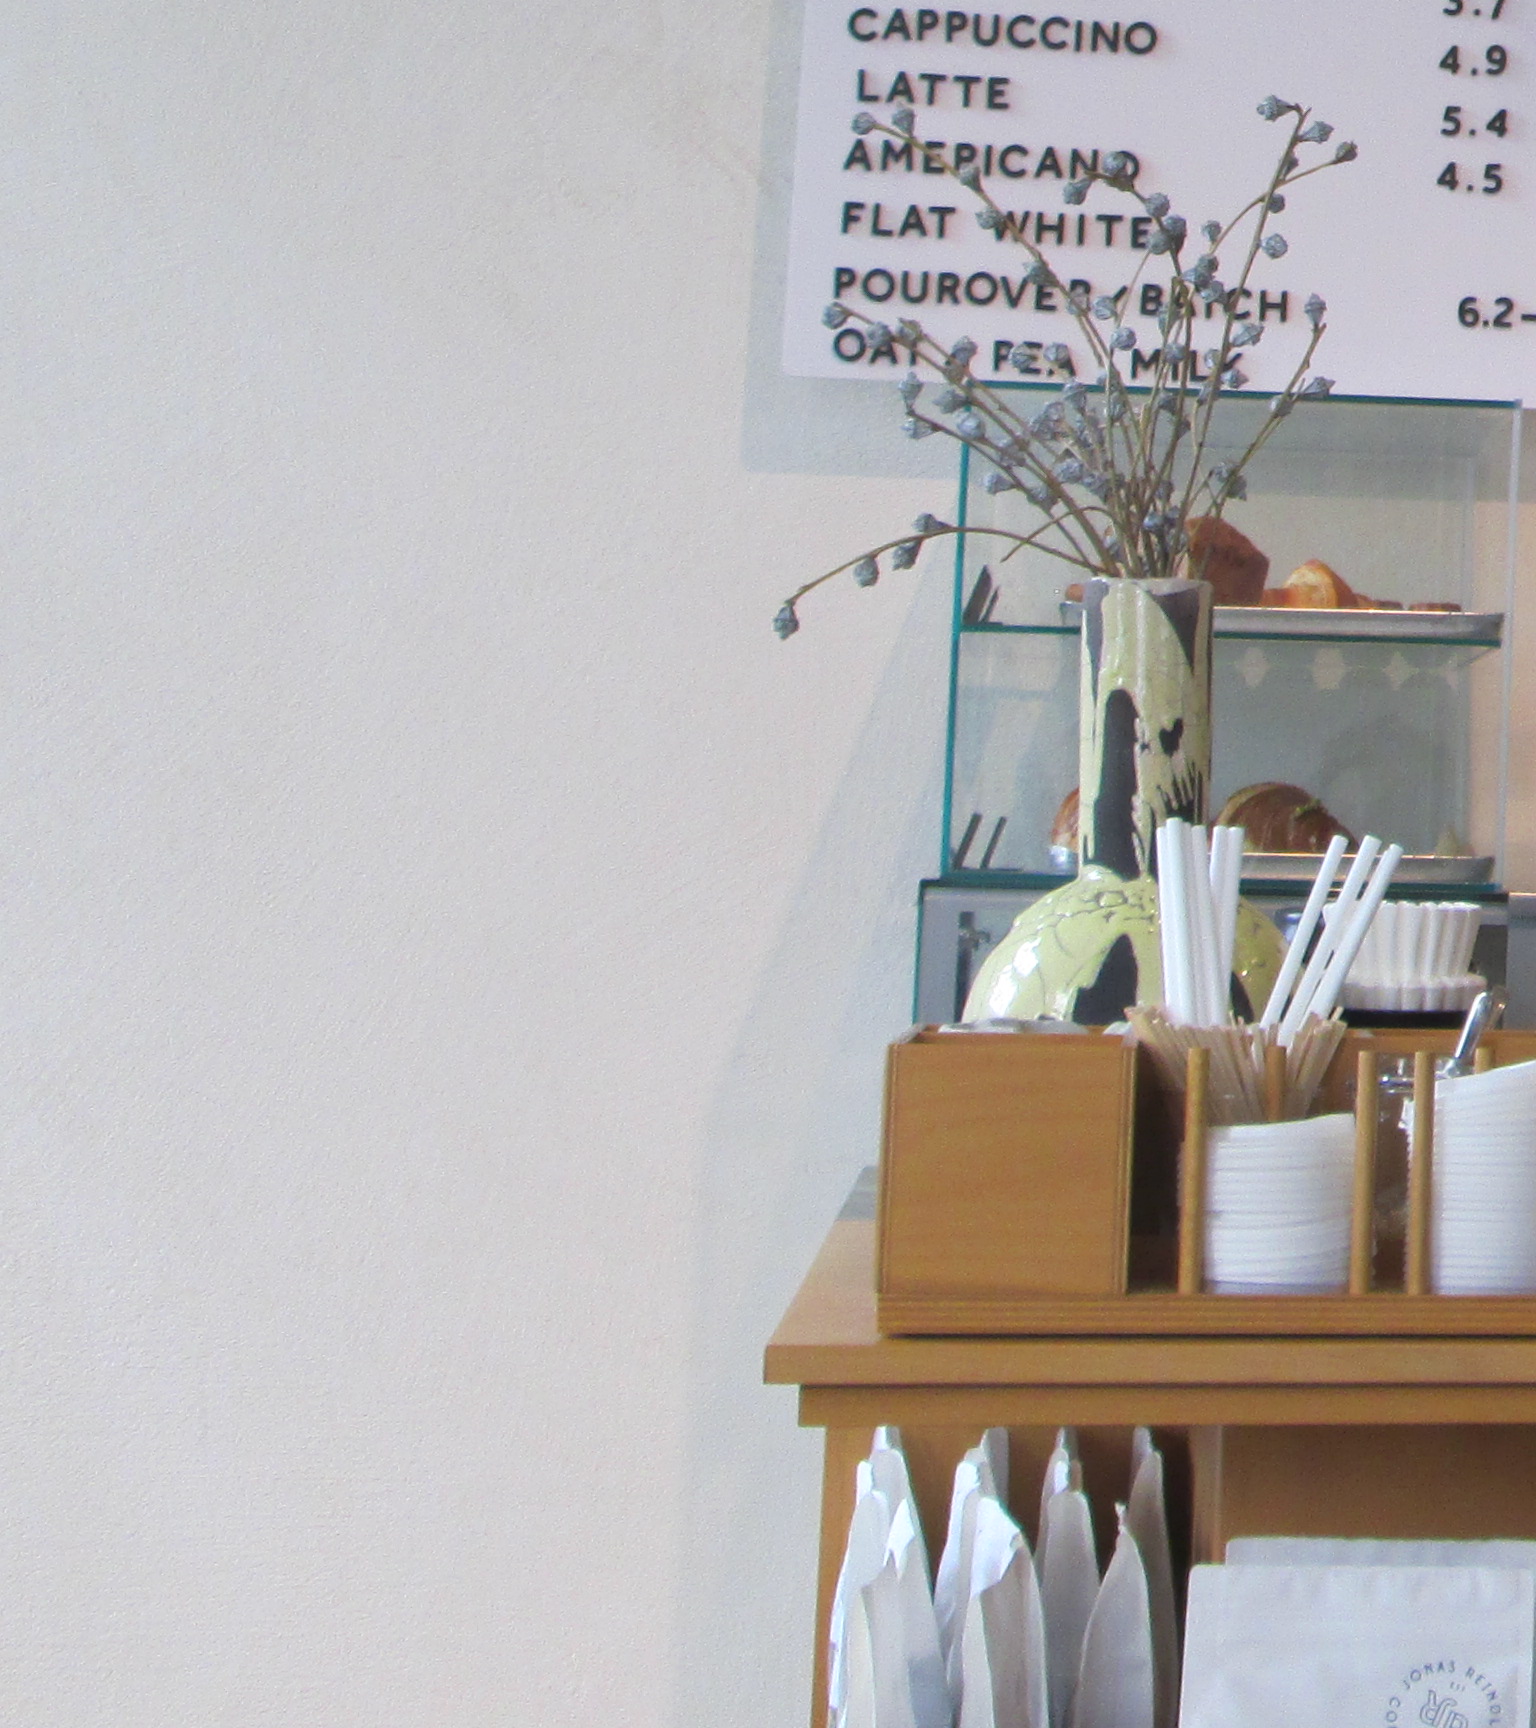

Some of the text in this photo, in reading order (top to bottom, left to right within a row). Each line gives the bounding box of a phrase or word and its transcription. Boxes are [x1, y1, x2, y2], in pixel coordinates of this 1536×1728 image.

[847, 7, 1159, 56] CAPPUCCINO
[1438, 44, 1508, 77] 4.9
[857, 69, 1011, 111] LATTE
[1440, 105, 1509, 138] 5.4
[843, 137, 1140, 181] AMERICANO
[1436, 161, 1504, 195] 4.5
[841, 201, 1152, 250] FLAT WHITE
[1402, 1659, 1502, 1727] JONAS REINDL
